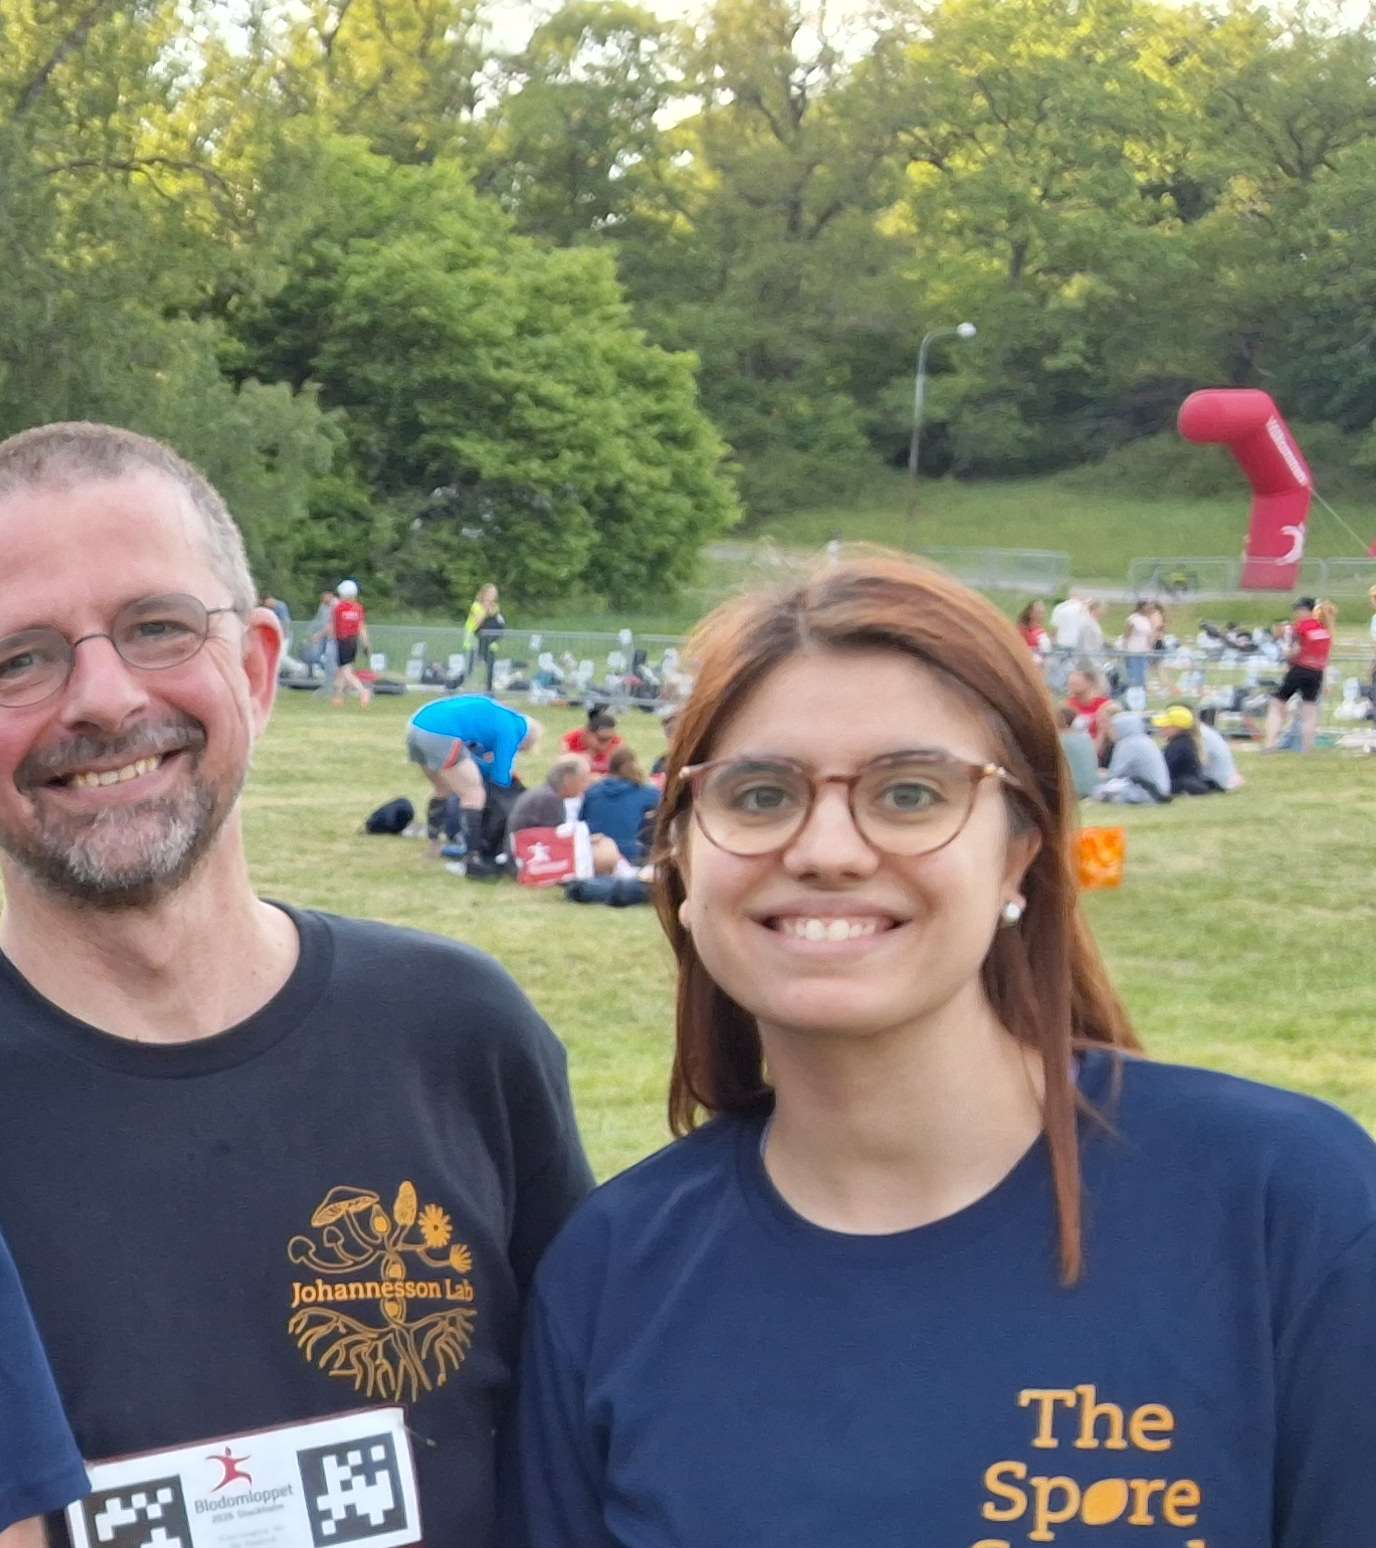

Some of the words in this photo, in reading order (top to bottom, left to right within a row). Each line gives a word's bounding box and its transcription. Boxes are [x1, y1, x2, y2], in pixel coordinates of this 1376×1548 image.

[291, 1278, 441, 1308] Johannesson
[445, 1278, 474, 1301] Lab
[1017, 1384, 1175, 1451] The
[982, 1460, 1202, 1541] Spore
